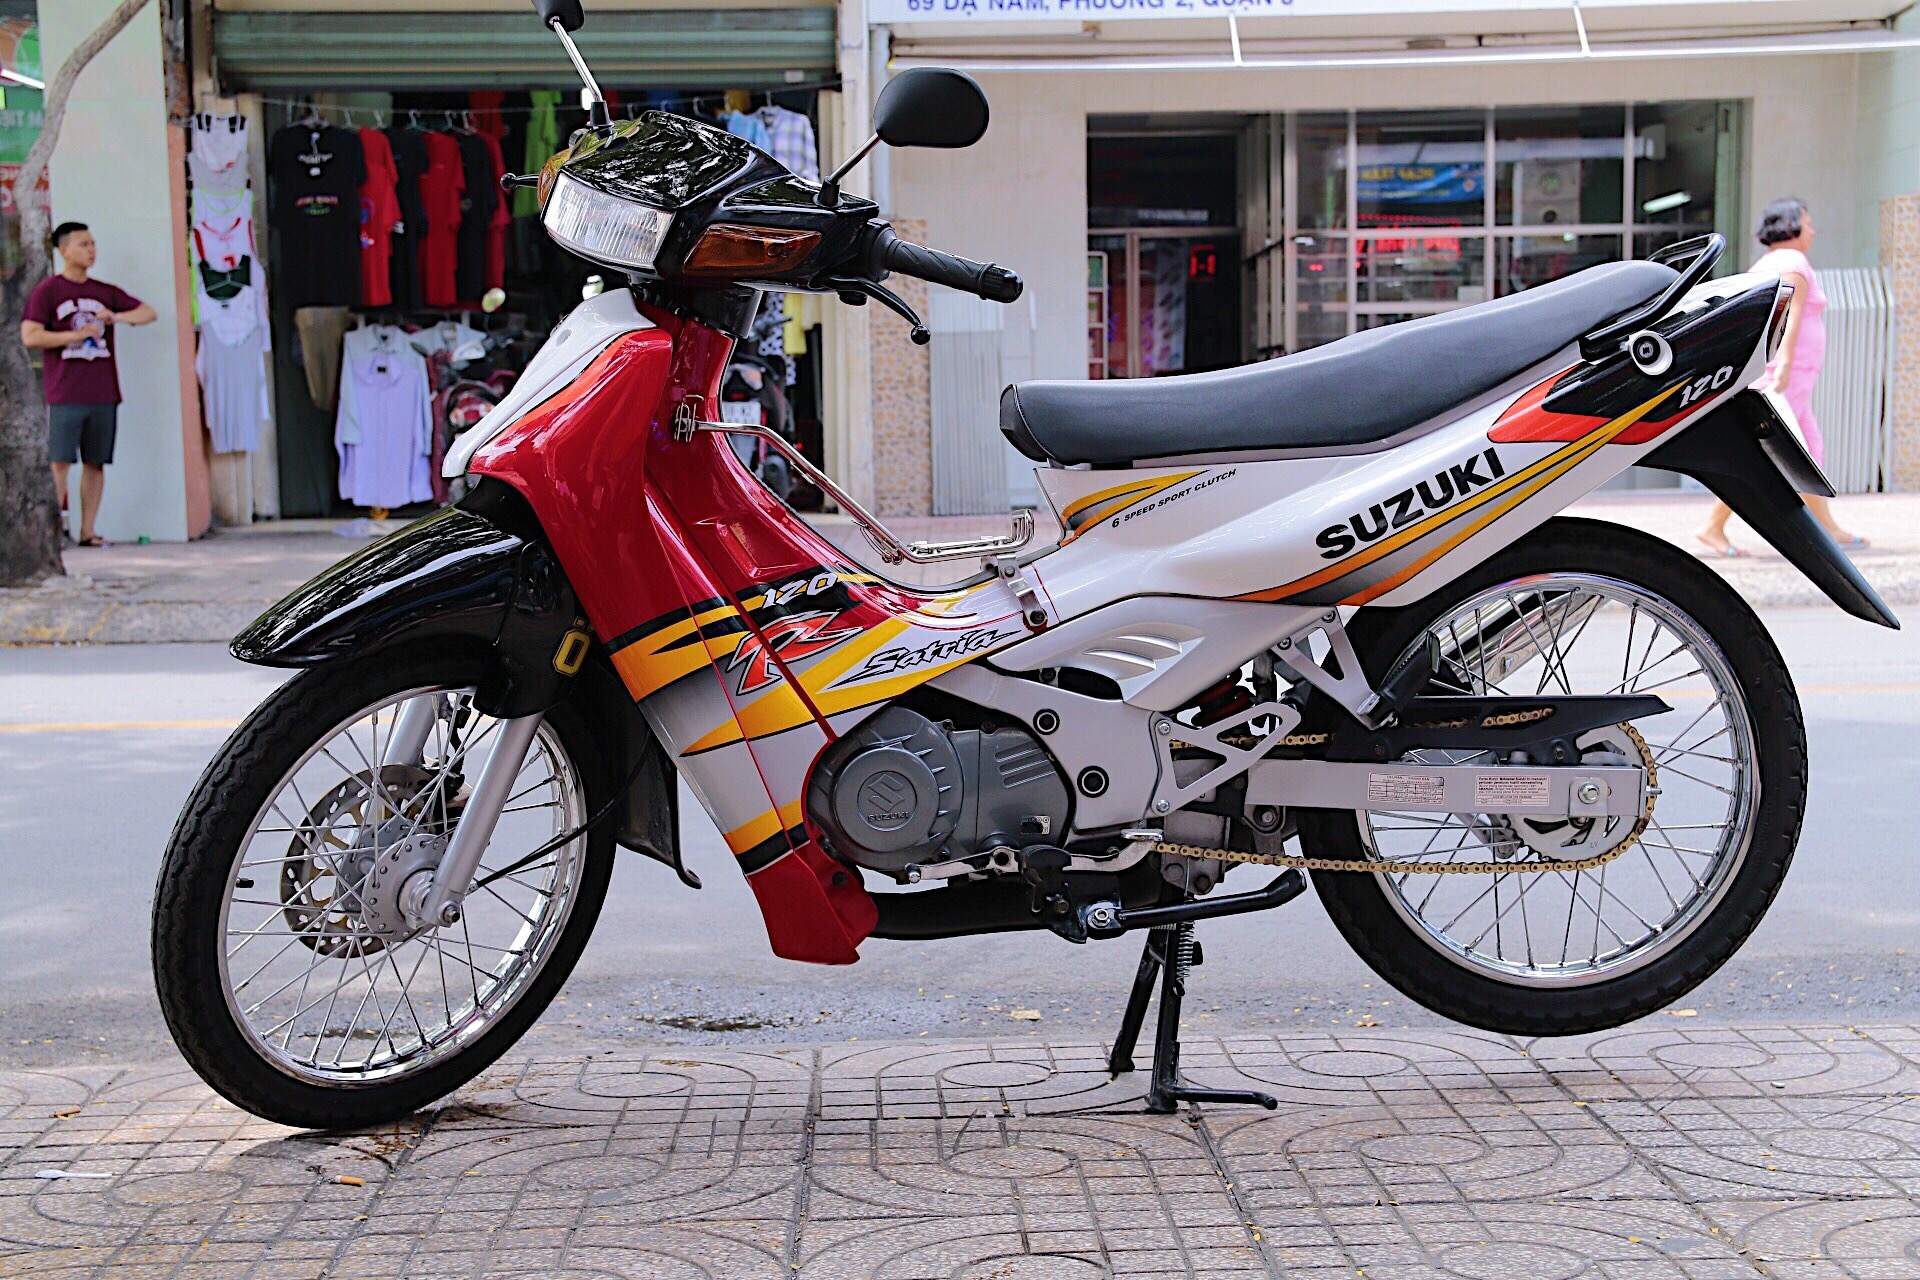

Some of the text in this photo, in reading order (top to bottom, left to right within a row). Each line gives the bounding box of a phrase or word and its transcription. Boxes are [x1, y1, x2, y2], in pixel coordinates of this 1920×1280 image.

[1679, 366, 1734, 408] 120
[1111, 469, 1237, 528] 6 SPEED SPORT CLUTCH
[1315, 447, 1506, 559] SUZUKI
[762, 572, 838, 609] 120
[827, 628, 1022, 690] Satria
